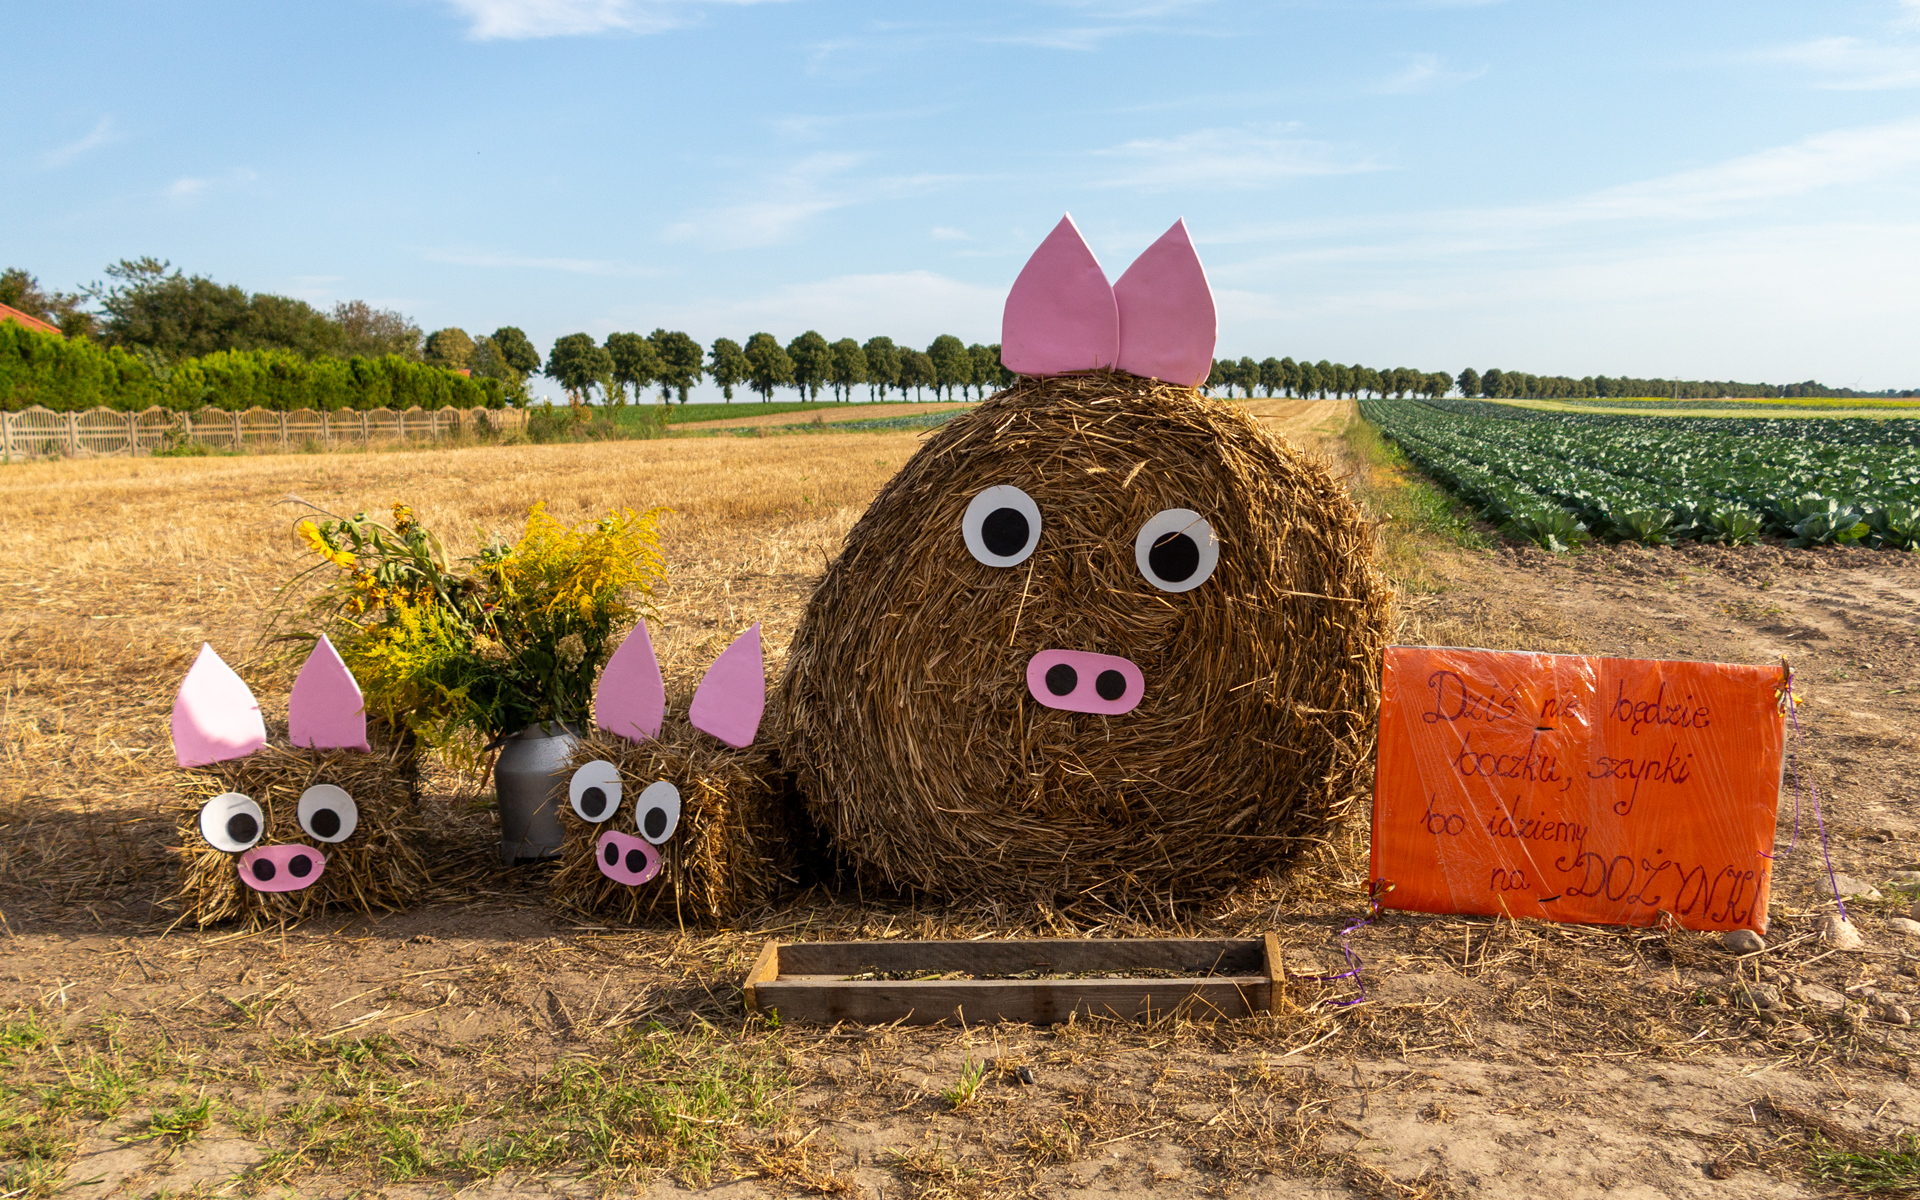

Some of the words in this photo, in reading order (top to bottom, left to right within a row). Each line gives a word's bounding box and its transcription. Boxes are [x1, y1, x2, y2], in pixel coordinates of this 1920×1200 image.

[1422, 670, 1519, 724] Dziś
[1540, 689, 1583, 720] nie
[1609, 678, 1711, 736] będzie
[1450, 731, 1573, 792] boczku,
[1586, 743, 1694, 816] szynki
[1420, 792, 1466, 836] bo
[1486, 795, 1589, 873] idziemy
[1490, 867, 1531, 892] na
[1565, 848, 1768, 926] DOŻYNKI
